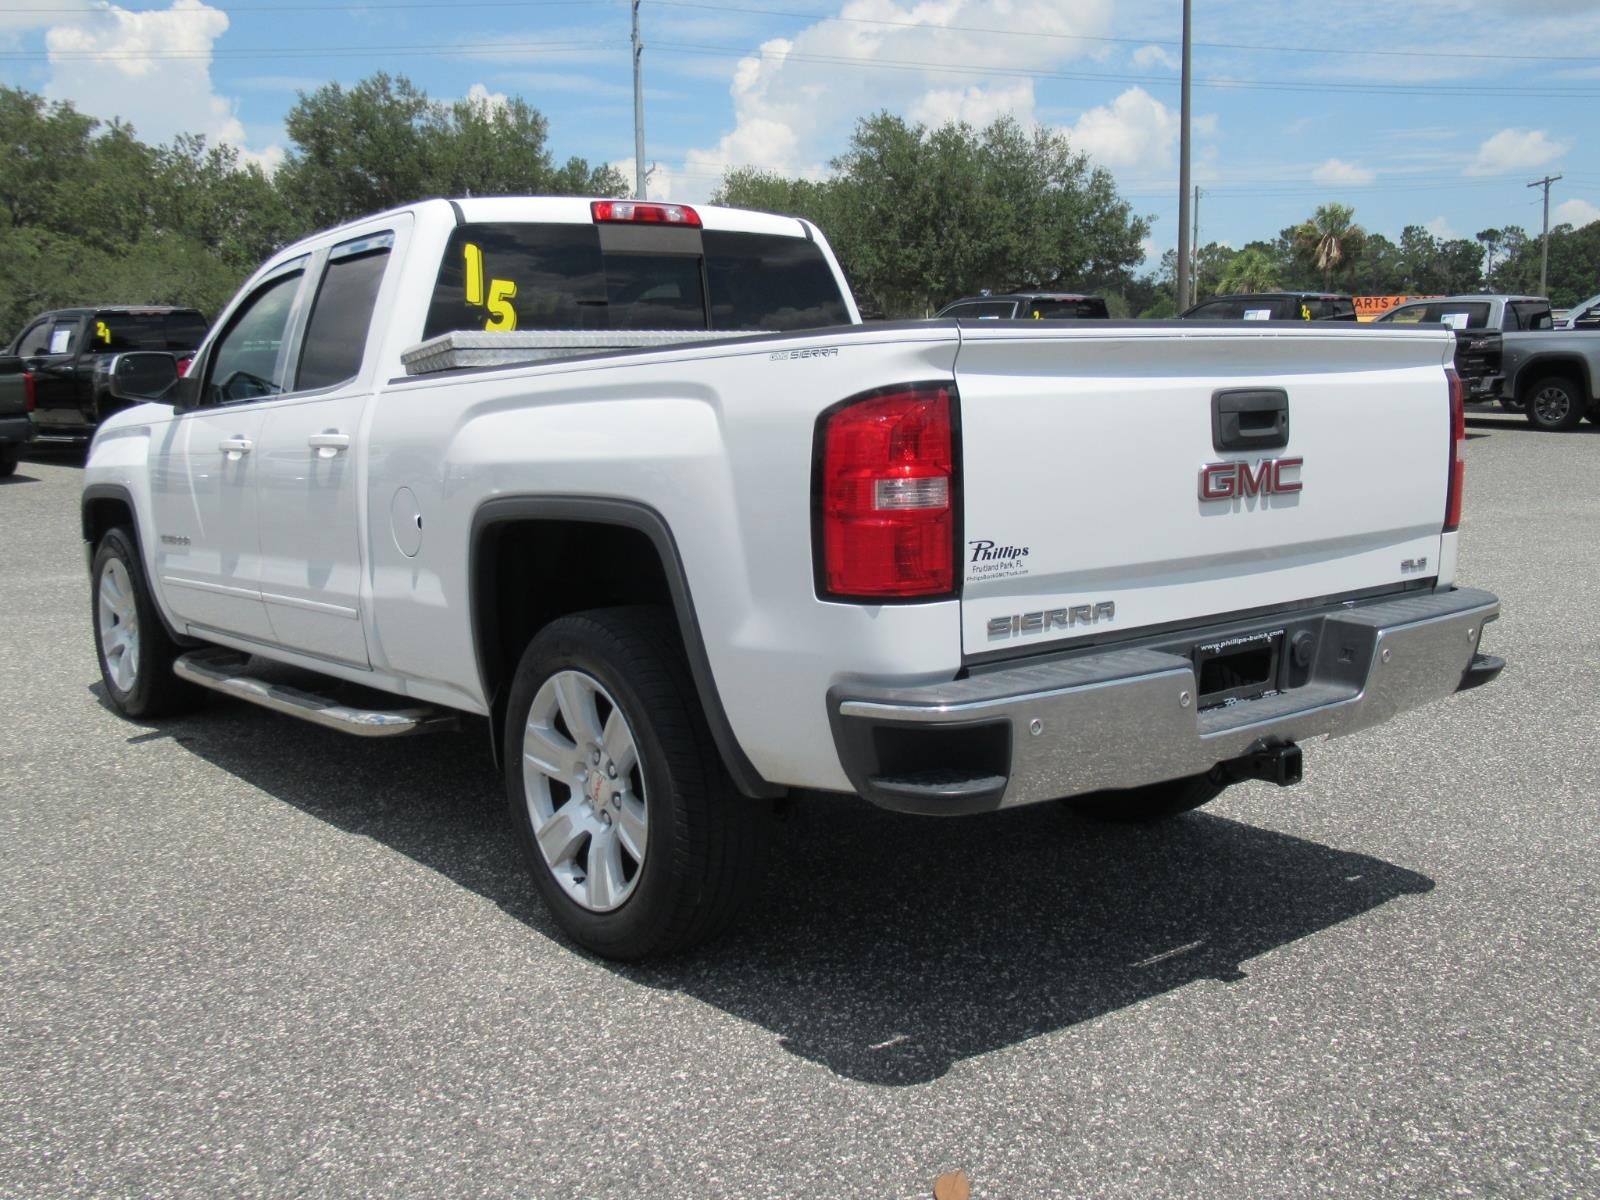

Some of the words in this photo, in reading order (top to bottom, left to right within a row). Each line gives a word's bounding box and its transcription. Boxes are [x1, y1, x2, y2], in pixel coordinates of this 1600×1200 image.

[96, 321, 112, 344] 21
[790, 347, 839, 360] SIERRA
[1198, 456, 1304, 502] GMC
[968, 539, 1029, 562] Phillips
[972, 562, 999, 574] Fruitland
[1000, 561, 1015, 570] Park,
[1016, 559, 1024, 568] FL
[986, 601, 1116, 636] SIERRA
